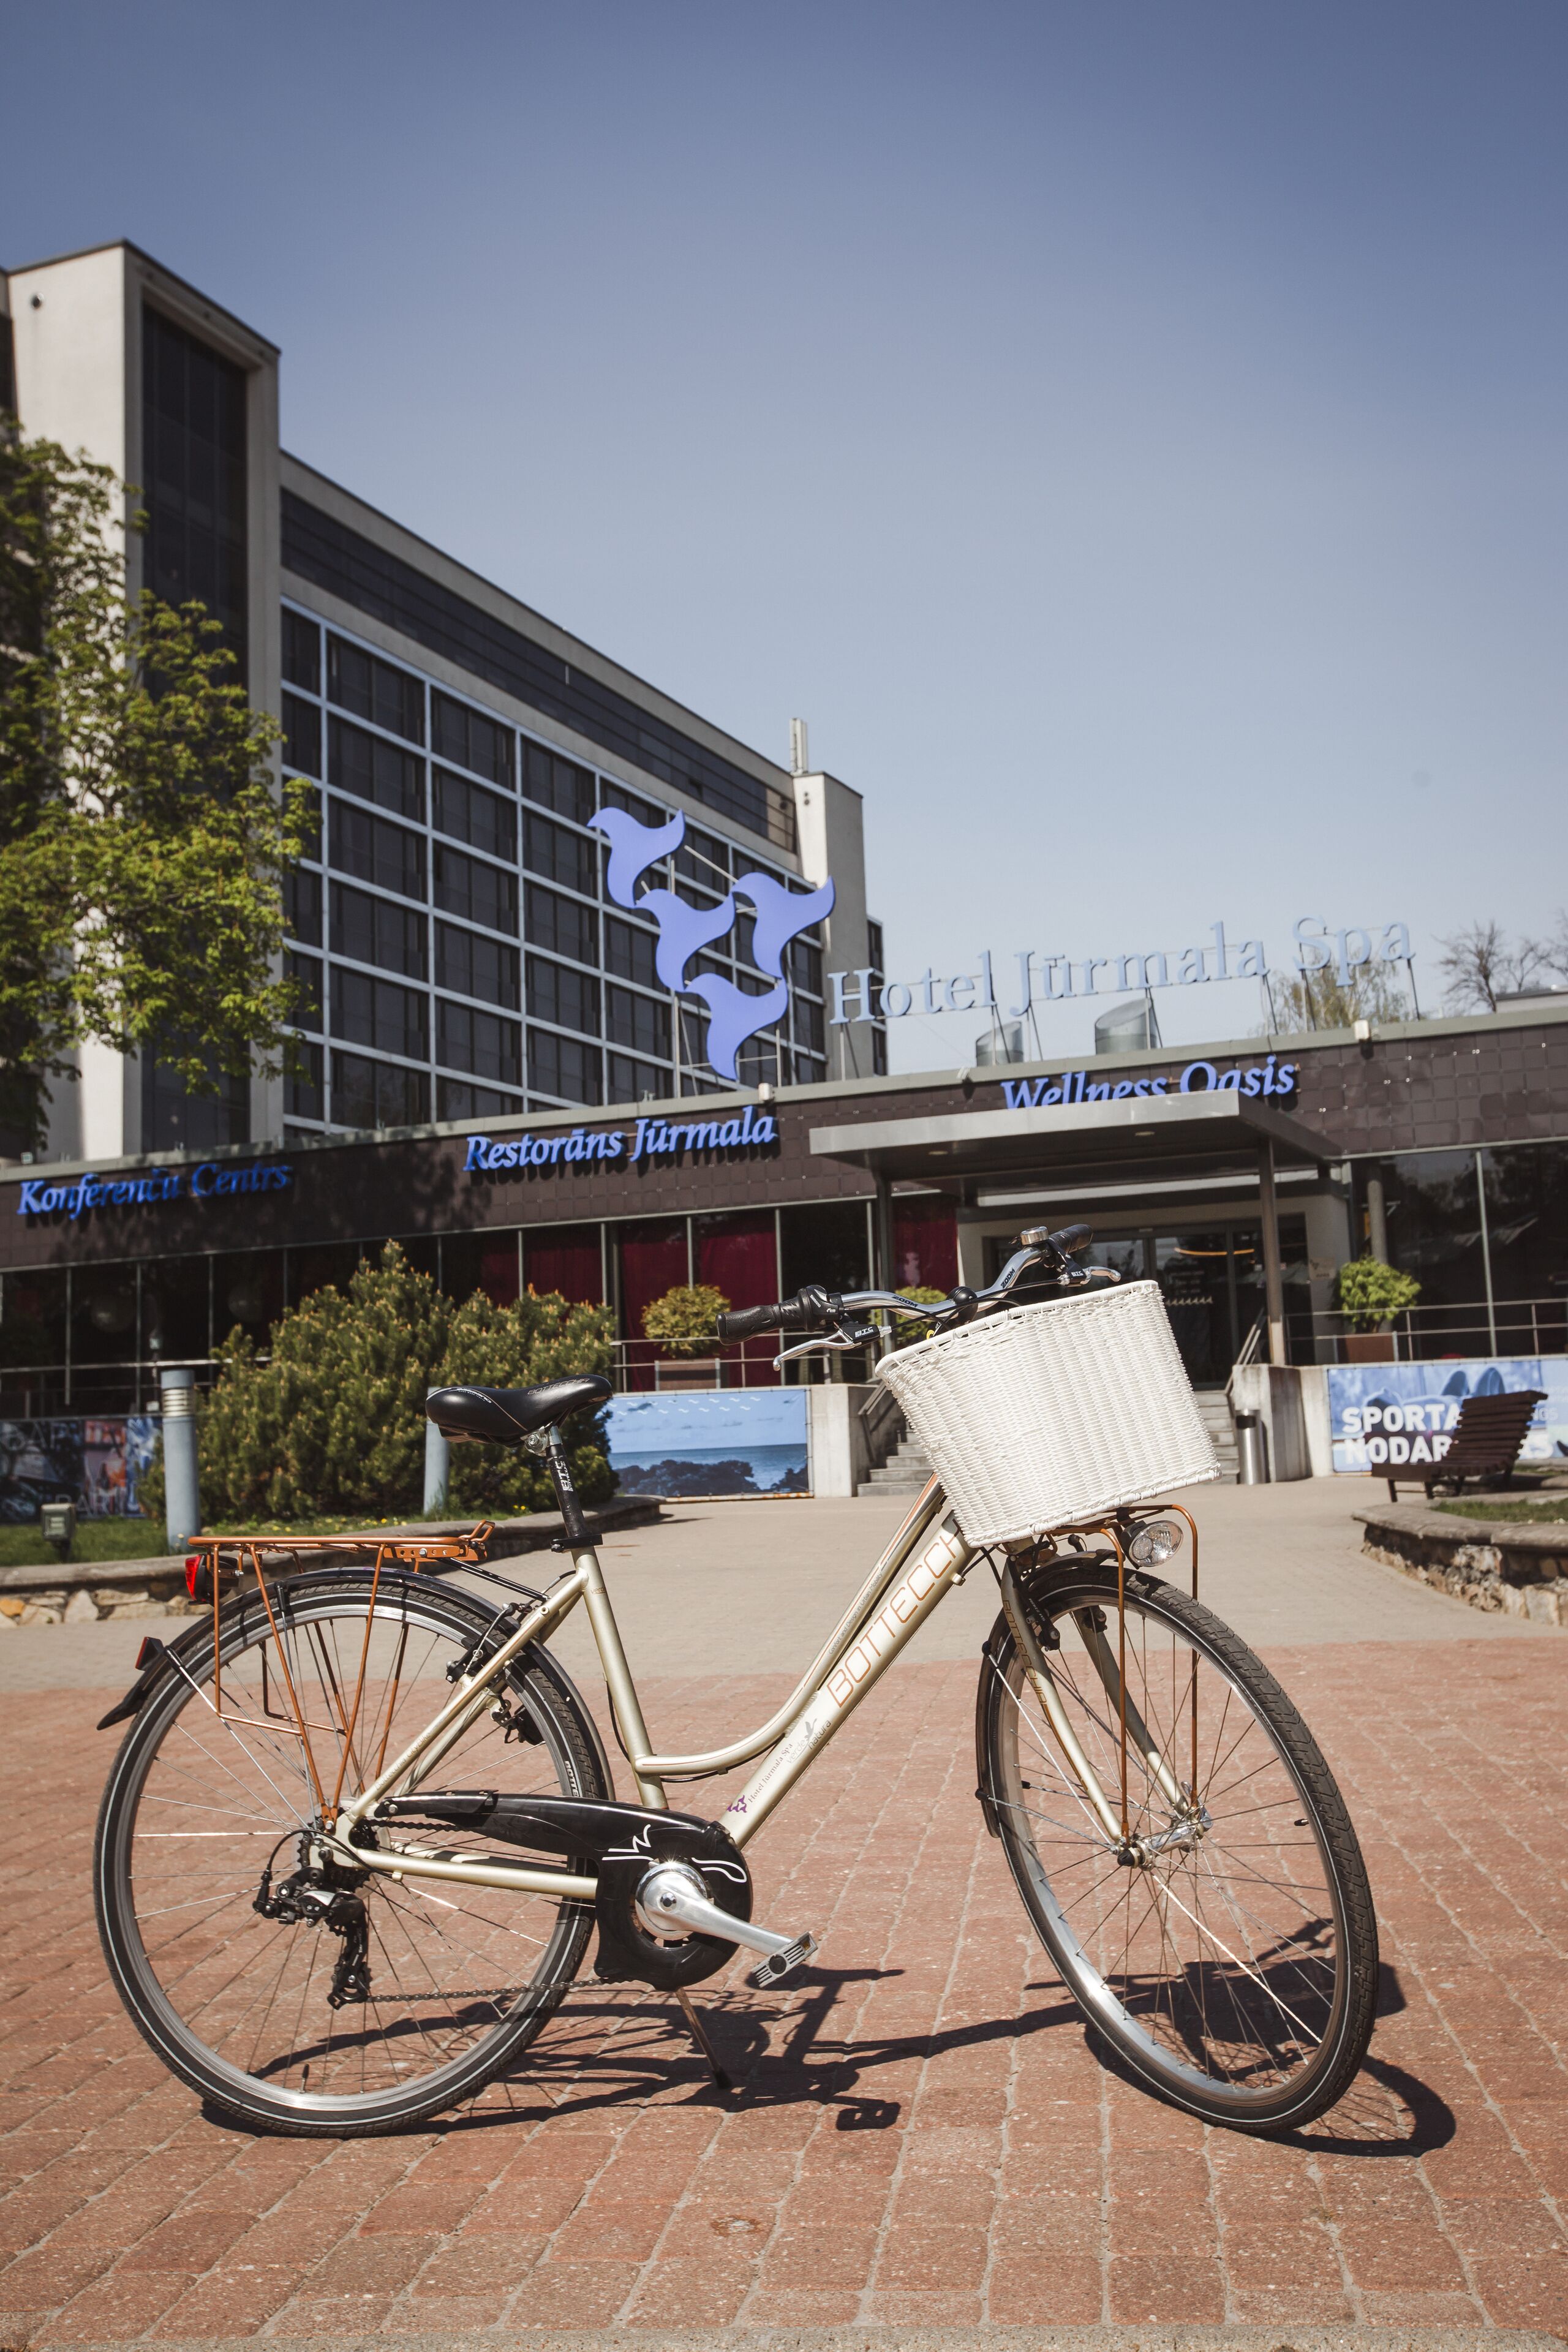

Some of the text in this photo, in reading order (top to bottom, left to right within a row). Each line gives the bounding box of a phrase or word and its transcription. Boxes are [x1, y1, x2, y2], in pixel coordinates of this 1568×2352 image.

[827, 916, 1415, 1024] Hotel Jūrmala Spa
[1000, 1055, 1295, 1110] Wellness Oasis
[463, 1106, 778, 1171] Restorāns Jūrmala
[191, 1162, 293, 1197] Centrs
[1001, 1268, 1016, 1288] ZOOM
[892, 1295, 919, 1308] ZOOM
[527, 1378, 590, 1395] BOTTECCHIA
[1341, 1403, 1463, 1433] SPORTA
[1003, 1600, 1047, 1705] BOTTECCHIA
[808, 1720, 831, 1750] natura
[748, 1783, 764, 1803] Hotel
[781, 1743, 793, 1757] Spa
